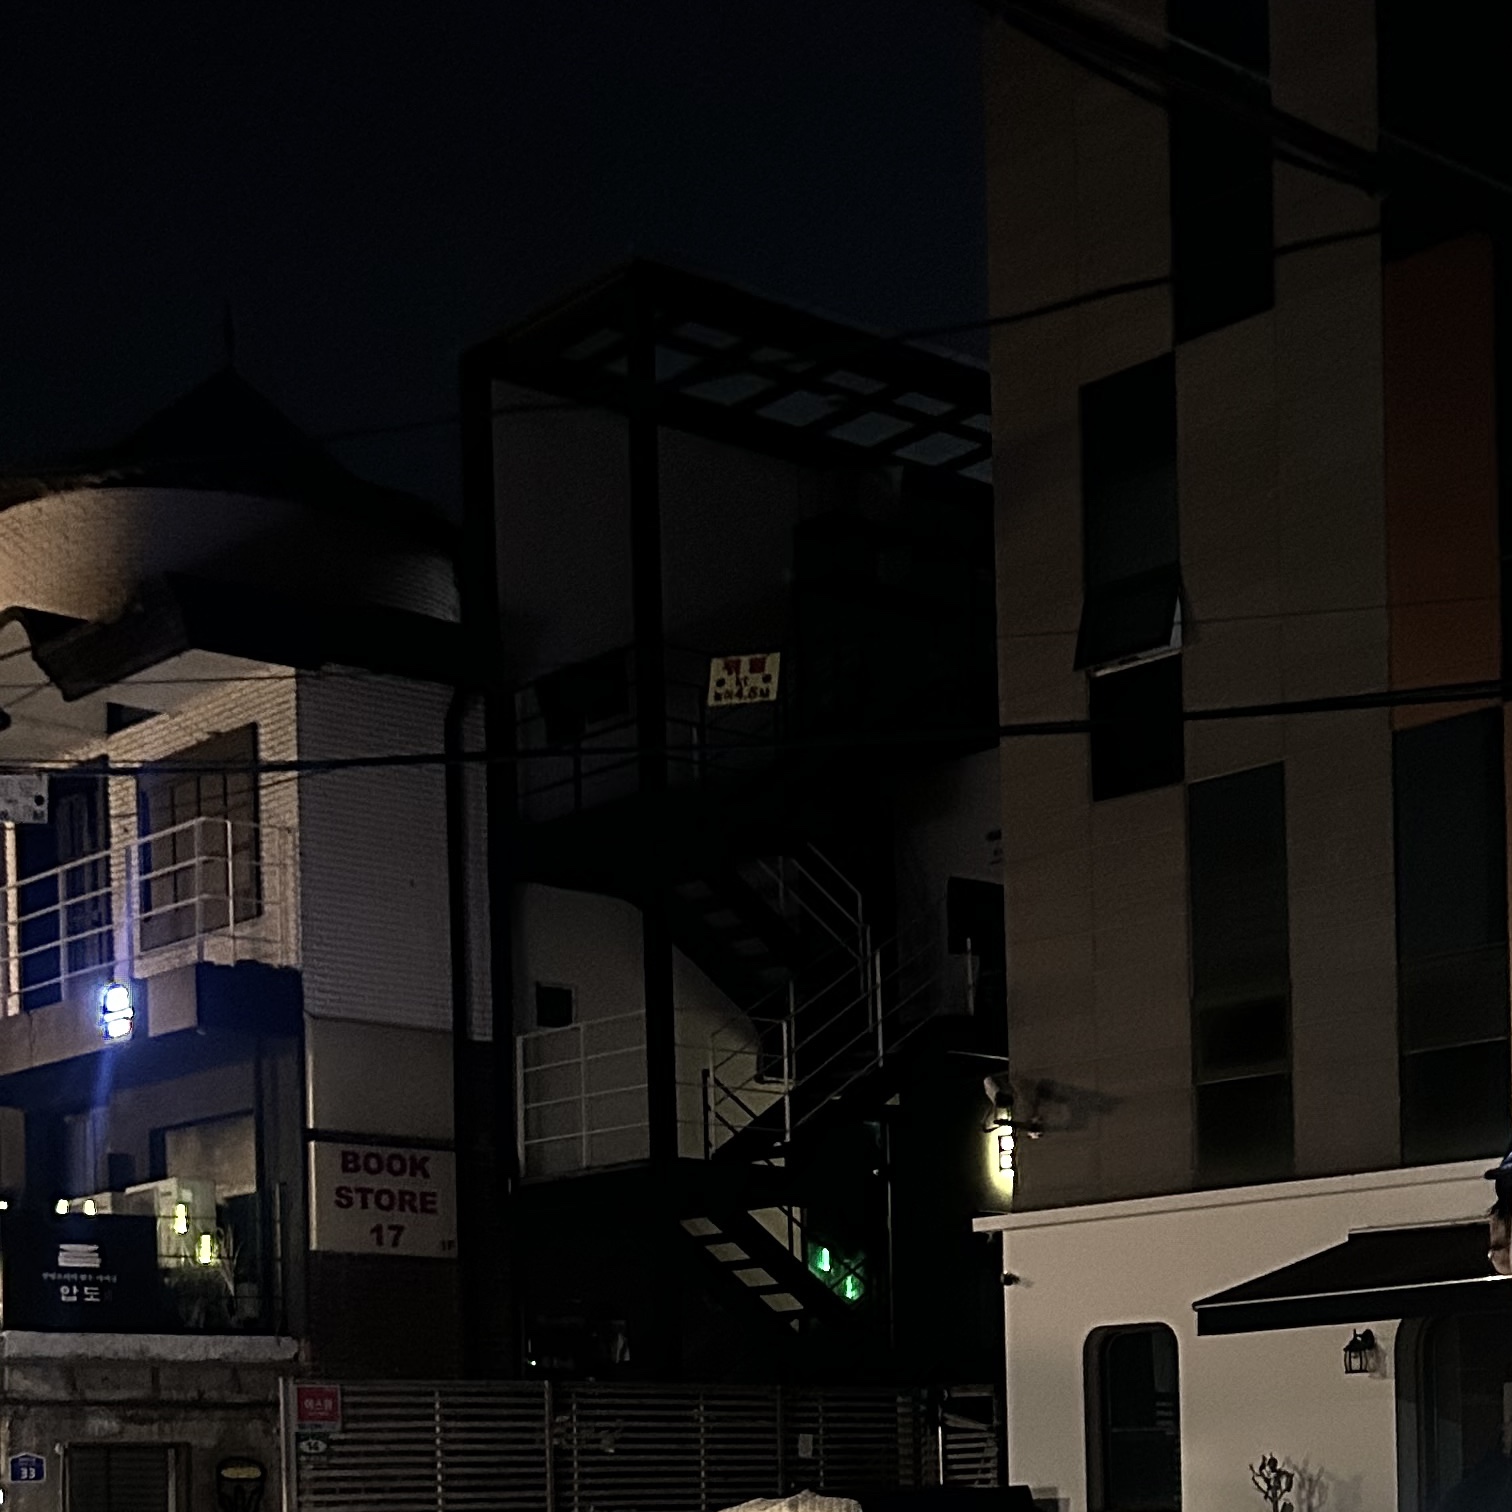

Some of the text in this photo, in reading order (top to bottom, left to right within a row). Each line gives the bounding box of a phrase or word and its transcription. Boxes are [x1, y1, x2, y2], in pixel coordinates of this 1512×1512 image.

[341, 1151, 431, 1178] BOOK
[334, 1186, 438, 1214] STORE
[370, 1223, 406, 1247] 17
